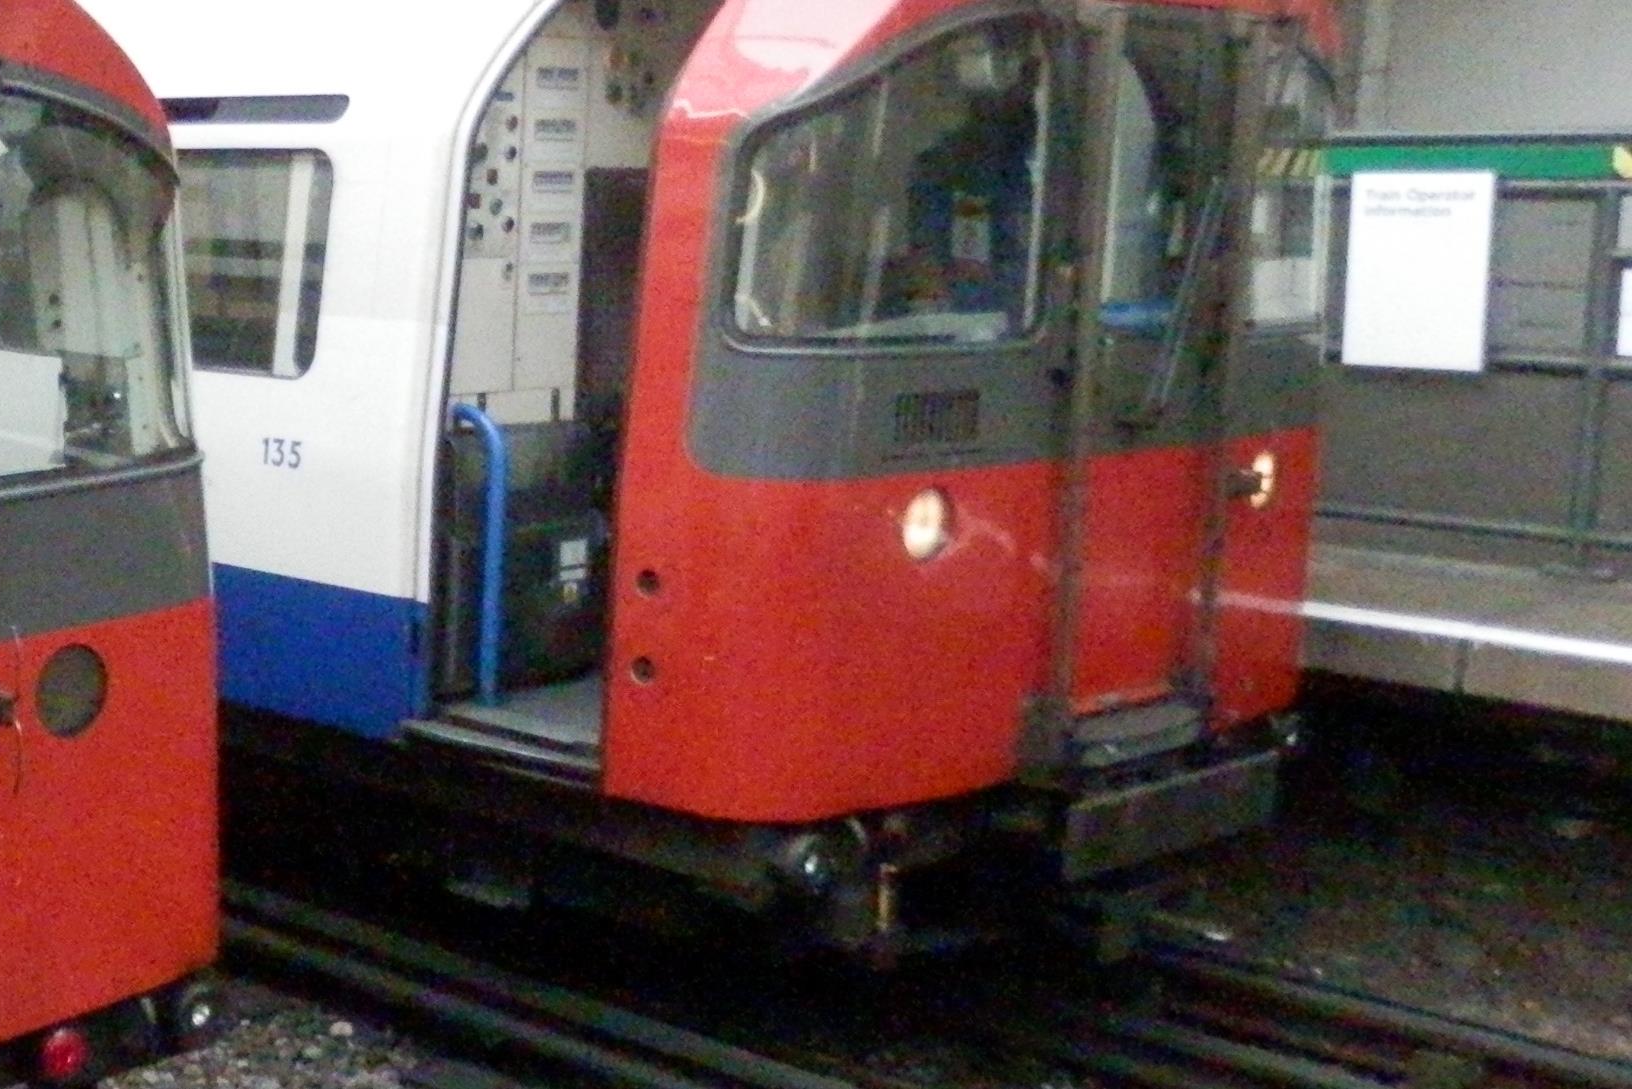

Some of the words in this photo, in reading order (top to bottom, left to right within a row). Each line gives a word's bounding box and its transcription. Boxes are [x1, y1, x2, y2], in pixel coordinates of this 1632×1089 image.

[1364, 188, 1401, 201] Train
[1406, 187, 1475, 203] Operator
[262, 437, 302, 469] 135
